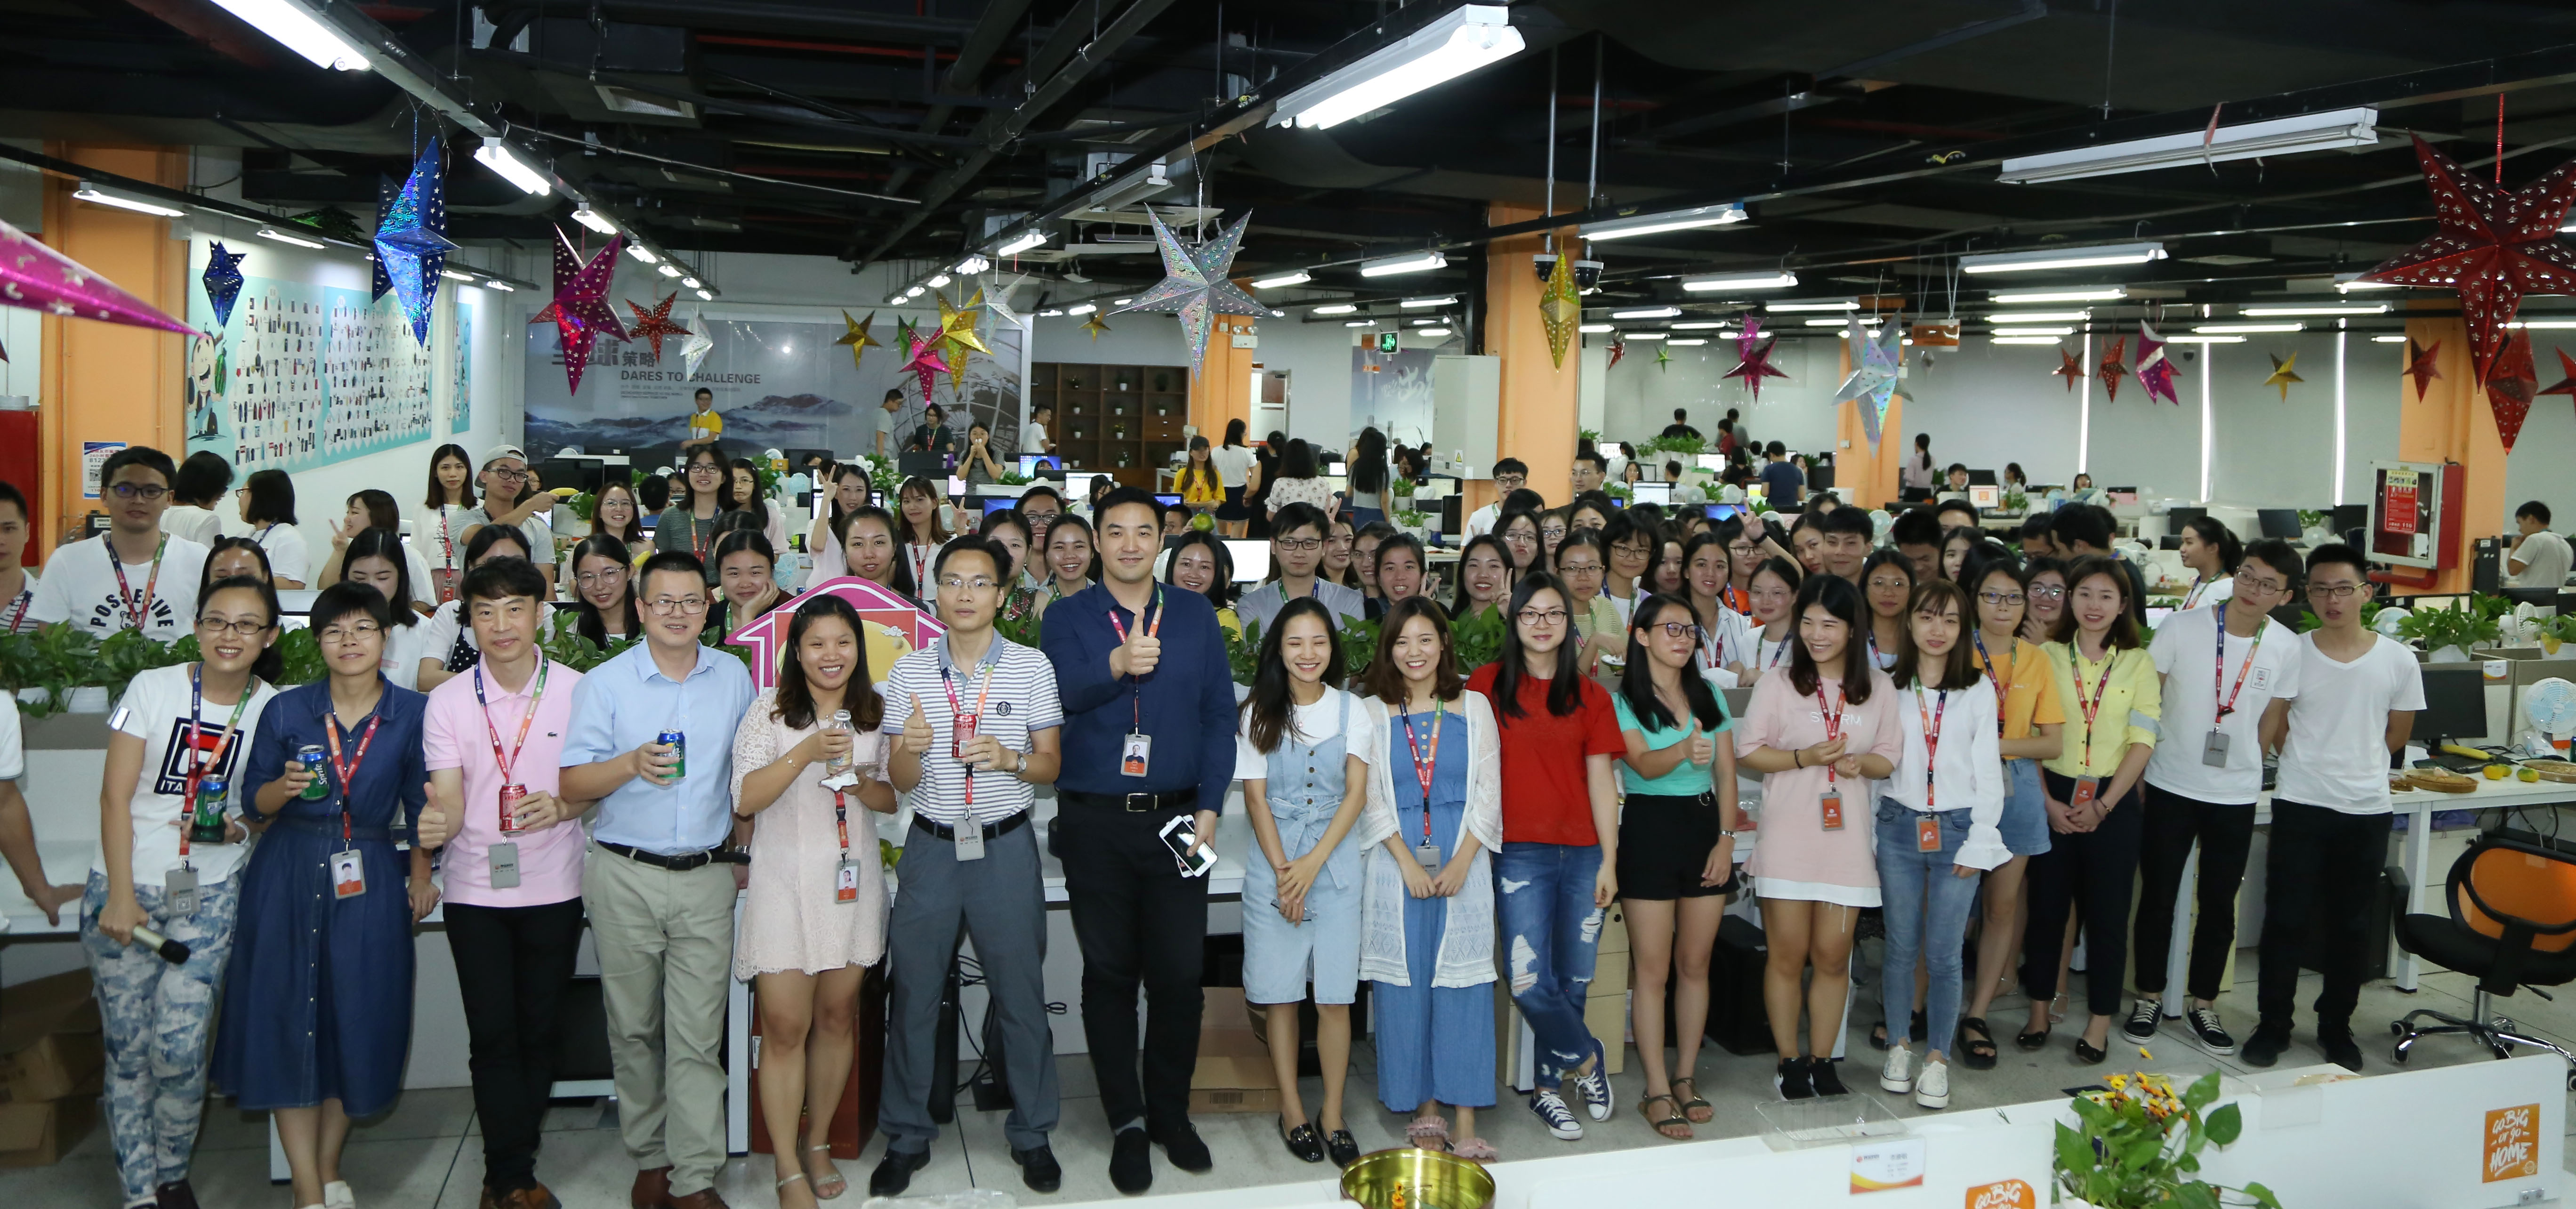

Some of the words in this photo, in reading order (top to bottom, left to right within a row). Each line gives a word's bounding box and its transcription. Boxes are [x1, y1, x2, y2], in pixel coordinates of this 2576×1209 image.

[622, 351, 656, 367] 策略
[621, 371, 663, 381] DARES
[667, 372, 683, 382] TO
[313, 763, 328, 785] Sprite
[160, 780, 187, 793] ITA
[2490, 1142, 2533, 1172] HOME
